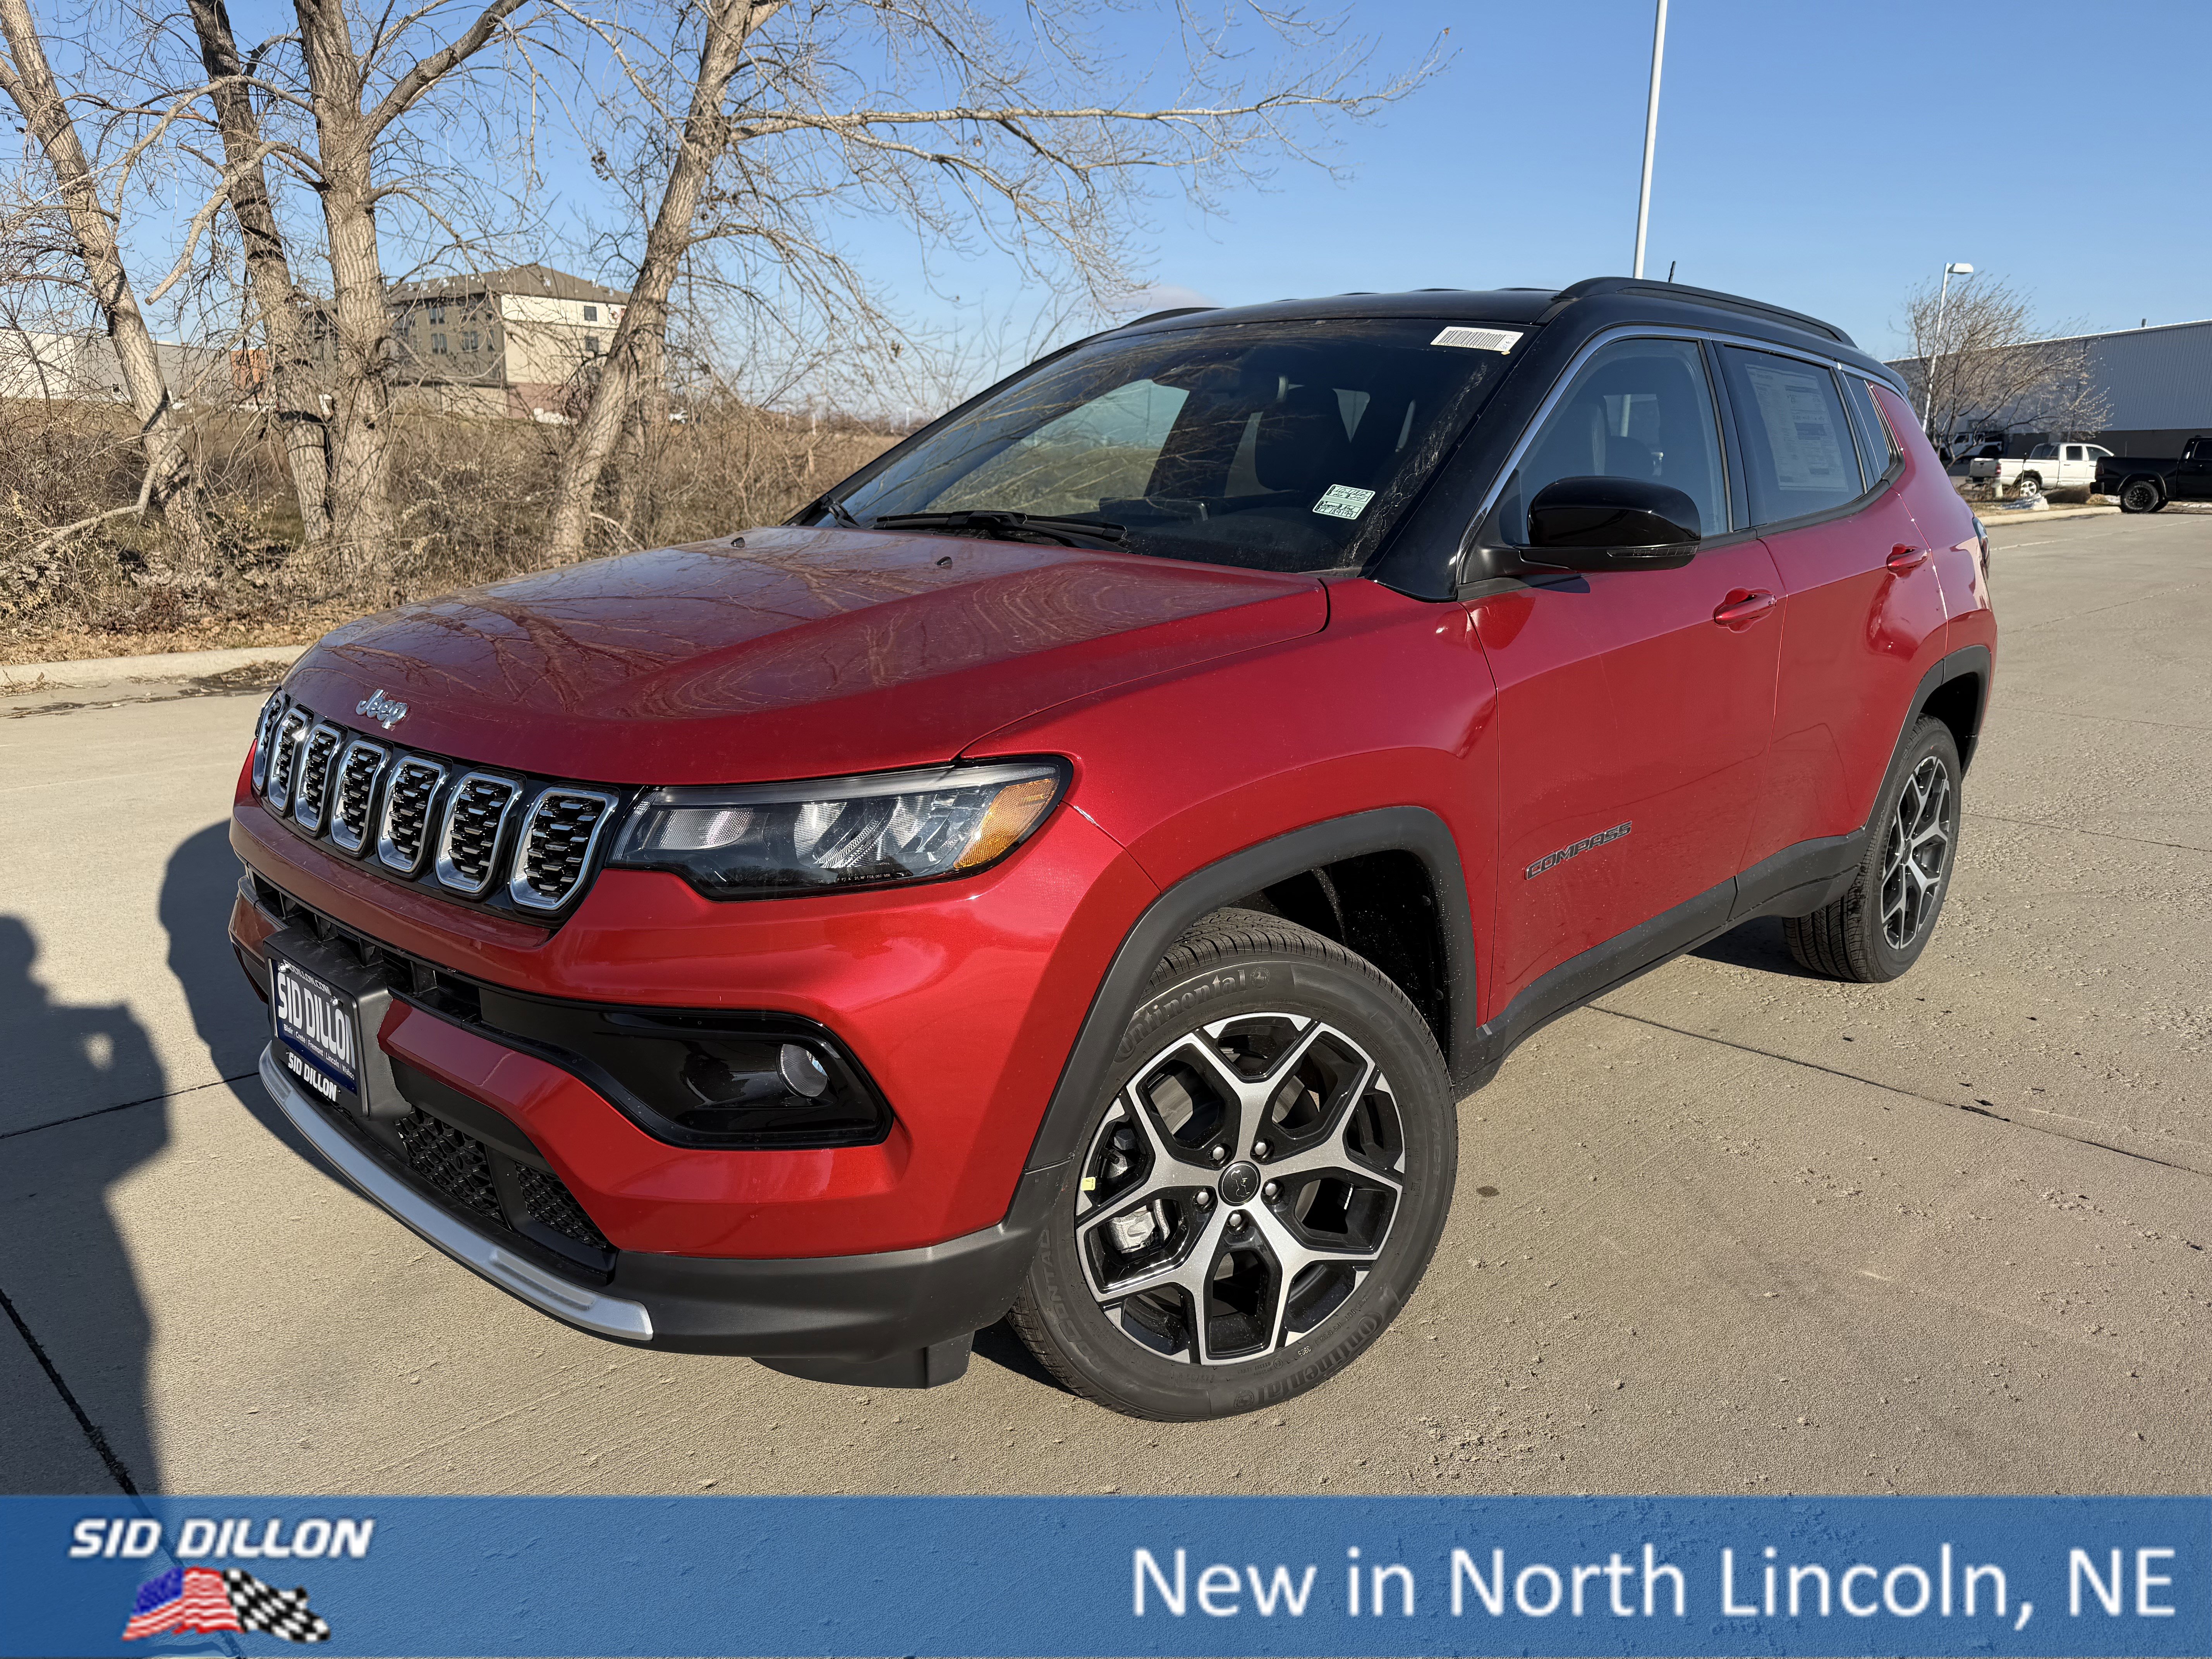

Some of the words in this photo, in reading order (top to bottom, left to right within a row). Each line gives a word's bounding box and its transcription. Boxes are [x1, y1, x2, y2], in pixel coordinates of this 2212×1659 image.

[356, 689, 408, 729] Jeep
[1525, 820, 1632, 880] COMPASS
[278, 972, 302, 1029] SID
[304, 988, 356, 1070] DILLON
[288, 1052, 302, 1076] SID
[304, 1063, 337, 1102] DILLON
[326, 1052, 339, 1068] Lincoln
[1258, 1312, 1383, 1405] Continental
